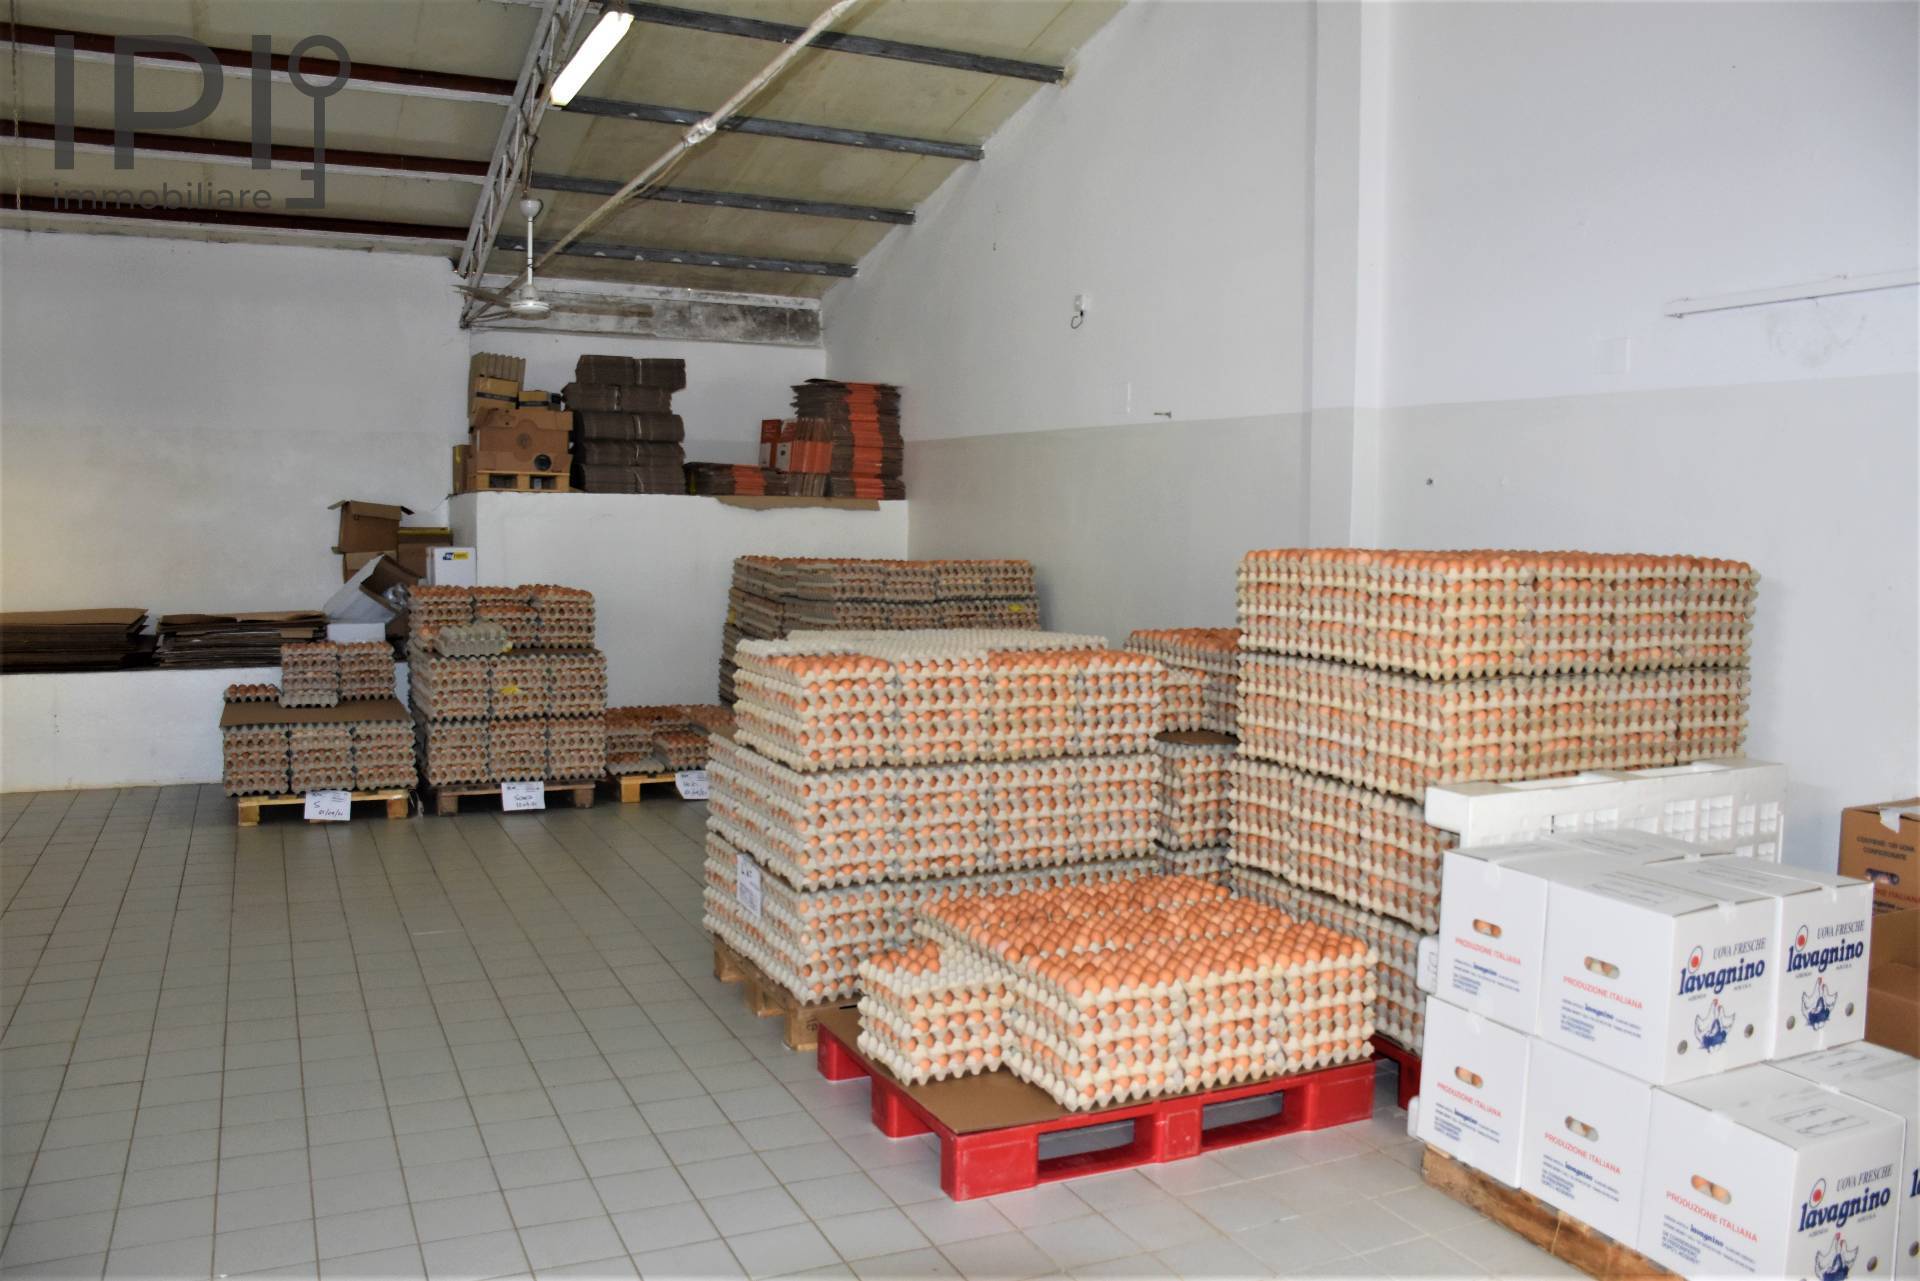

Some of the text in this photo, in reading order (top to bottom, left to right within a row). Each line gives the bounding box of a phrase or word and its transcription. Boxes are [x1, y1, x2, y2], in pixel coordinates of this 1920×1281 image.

[1816, 919, 1865, 940] UOVA FRESCHE
[1712, 936, 1767, 961] UOVA FRESCHE
[1786, 937, 1864, 974] lavagnino
[1562, 975, 1608, 1000] PRODUZIONE
[1608, 991, 1643, 1010] ITALIANA
[1677, 957, 1766, 996] lavagnino
[1544, 1131, 1587, 1159] PRODUZIONE
[1588, 1152, 1622, 1175] ITALIANA
[1837, 1177, 1857, 1192] UOVA
[1857, 1164, 1894, 1187] FRESCHE
[1665, 1190, 1719, 1223] PRODUZIONE
[1719, 1216, 1759, 1243] ITALIANA
[1798, 1186, 1891, 1232] lavagnino
